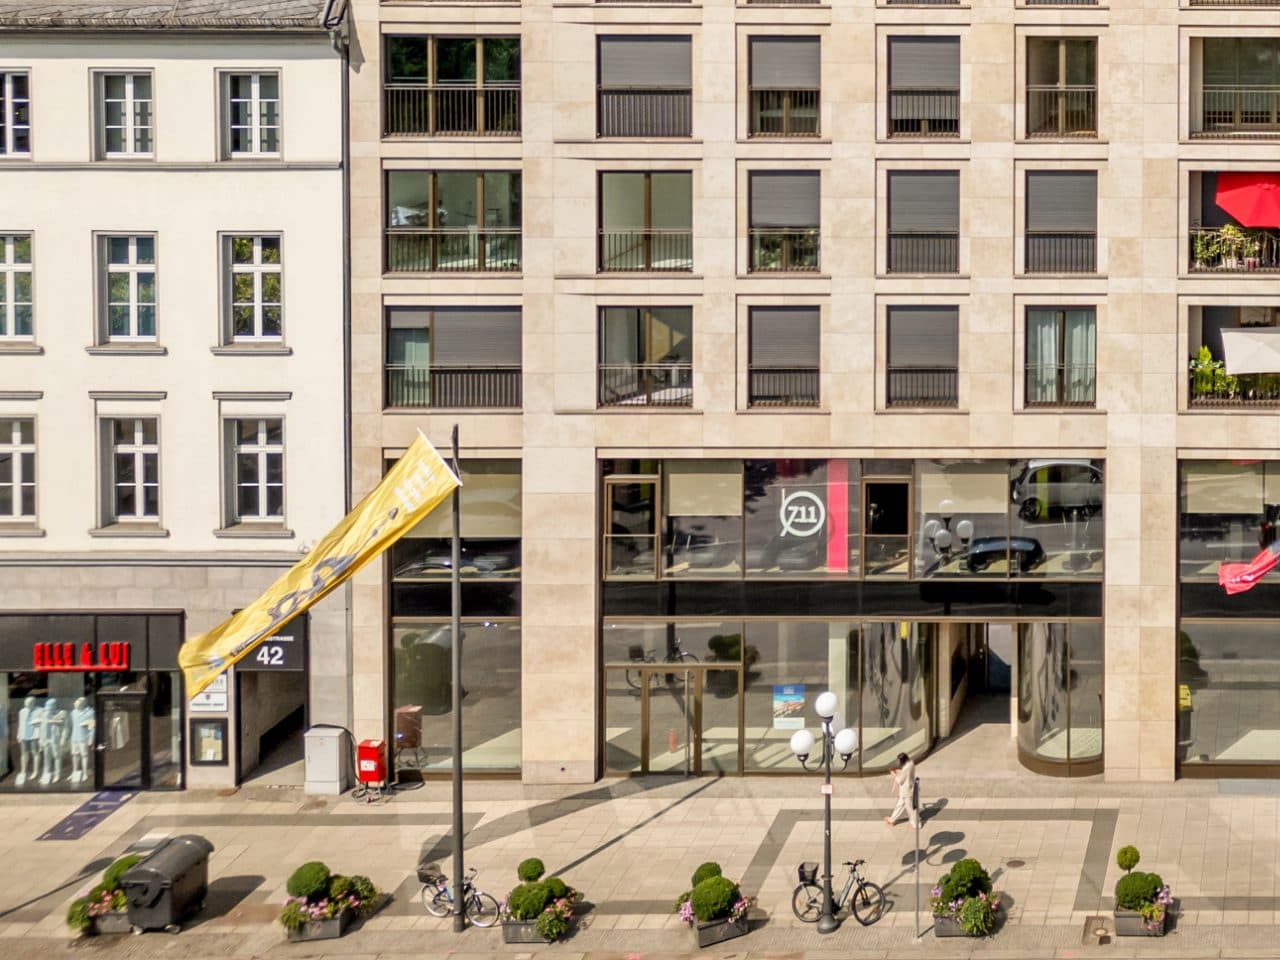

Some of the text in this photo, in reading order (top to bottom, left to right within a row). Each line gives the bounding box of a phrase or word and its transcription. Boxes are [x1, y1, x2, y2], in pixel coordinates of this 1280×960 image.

[34, 642, 74, 666] ELLE
[99, 641, 130, 666] LUI
[256, 646, 285, 665] 42
